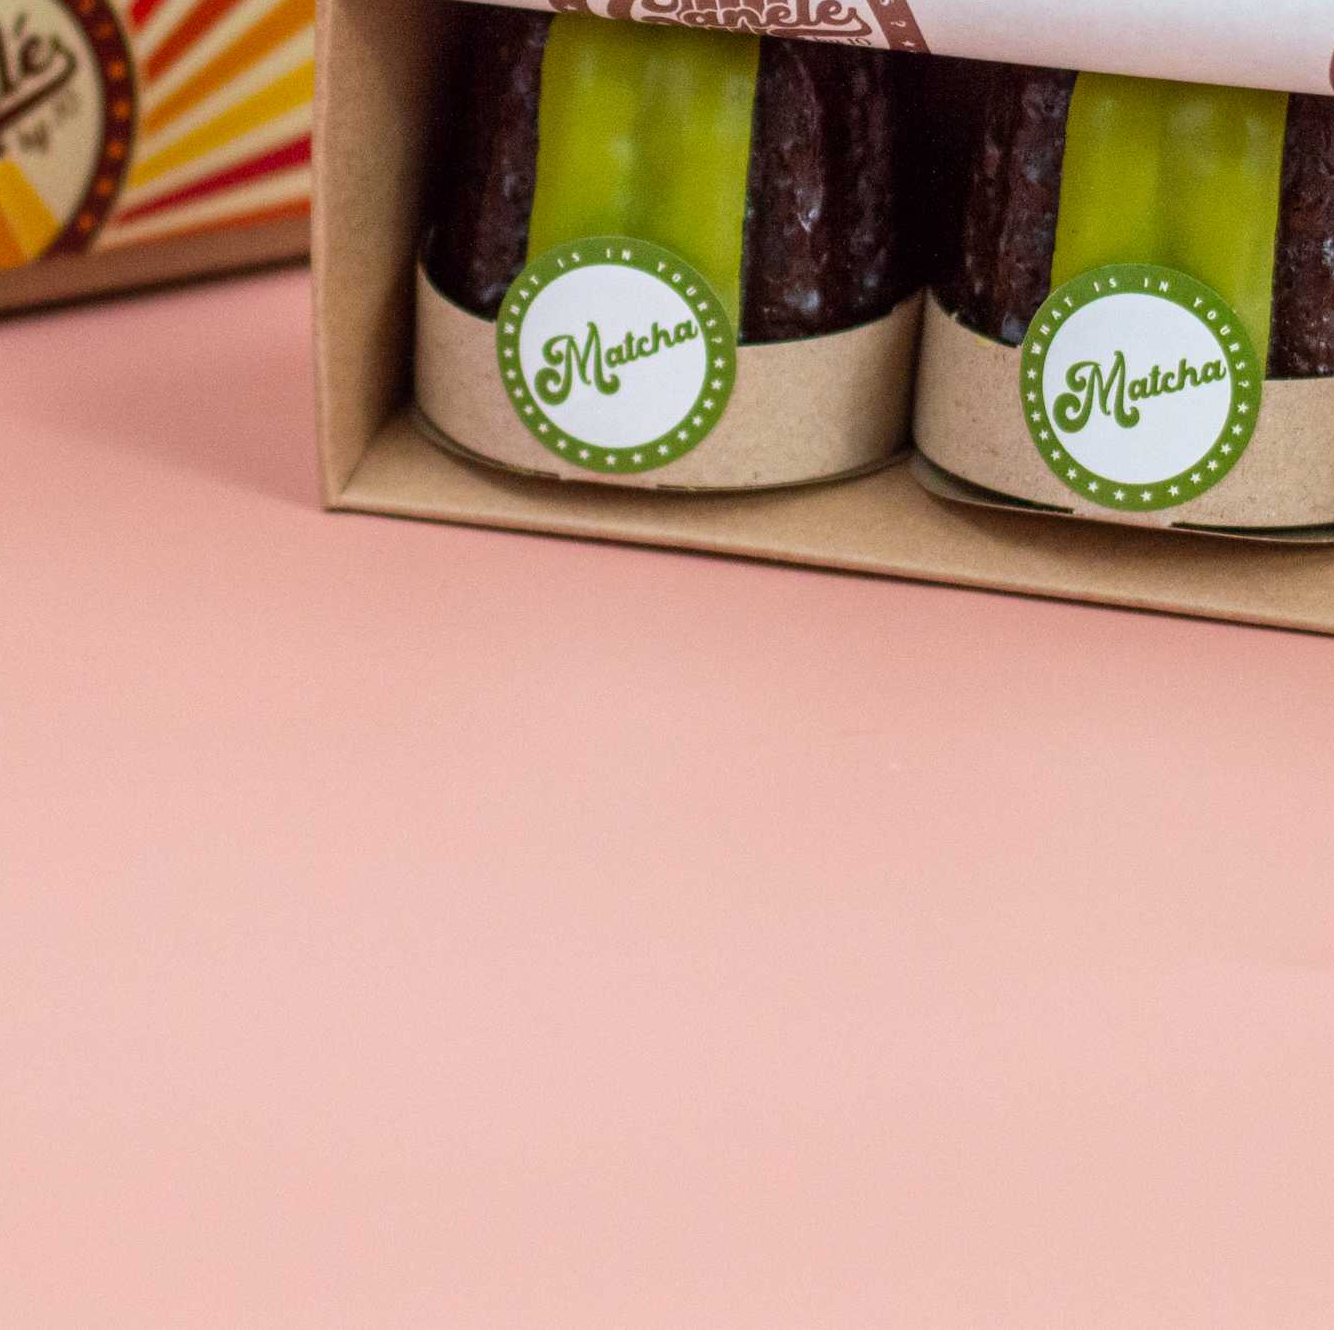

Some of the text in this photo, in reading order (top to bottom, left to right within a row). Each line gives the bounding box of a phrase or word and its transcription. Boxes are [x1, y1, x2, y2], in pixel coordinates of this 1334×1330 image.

[503, 274, 541, 335] WHAT
[556, 252, 581, 268] IS
[605, 248, 632, 261] IN
[1030, 296, 1074, 355] WHAT
[1093, 277, 1117, 292] IS
[1143, 277, 1170, 292] IN
[534, 319, 699, 407] Matcha
[1053, 349, 1227, 434] Matcha
